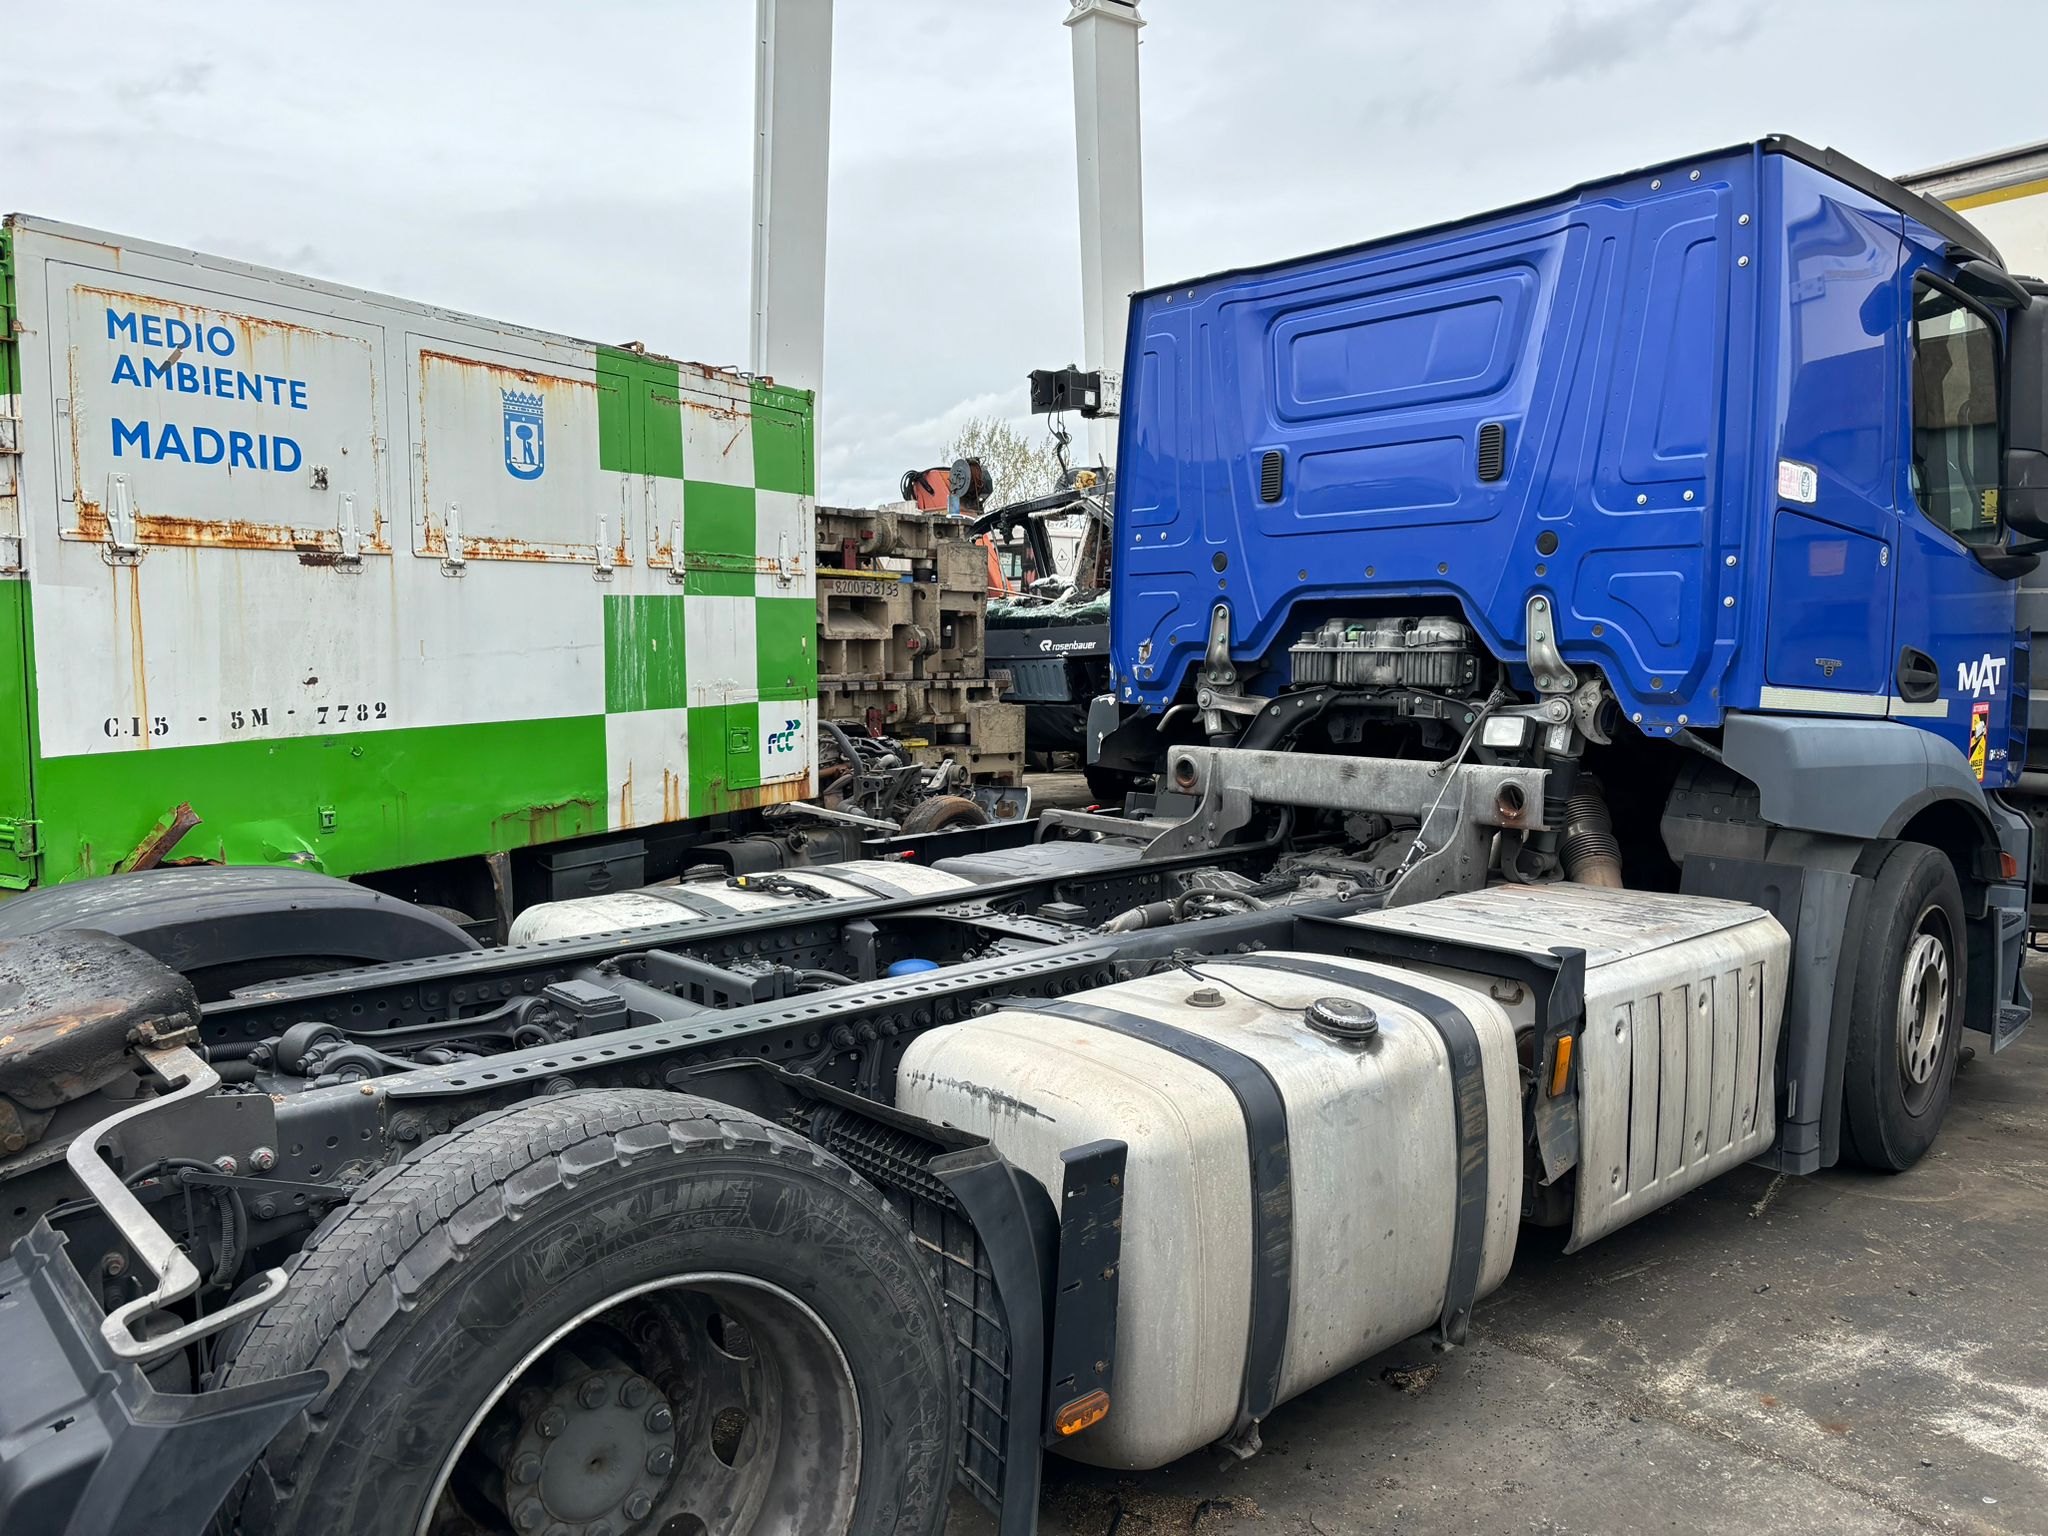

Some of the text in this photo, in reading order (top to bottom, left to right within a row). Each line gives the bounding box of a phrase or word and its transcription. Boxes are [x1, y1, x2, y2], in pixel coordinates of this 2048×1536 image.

[106, 308, 235, 357] MEDIO
[111, 354, 308, 410] AMBIENTE
[111, 418, 302, 472] MADRID
[1052, 641, 1096, 651] rosenbauer
[1957, 653, 2006, 698] MAT
[317, 702, 387, 724] 7782
